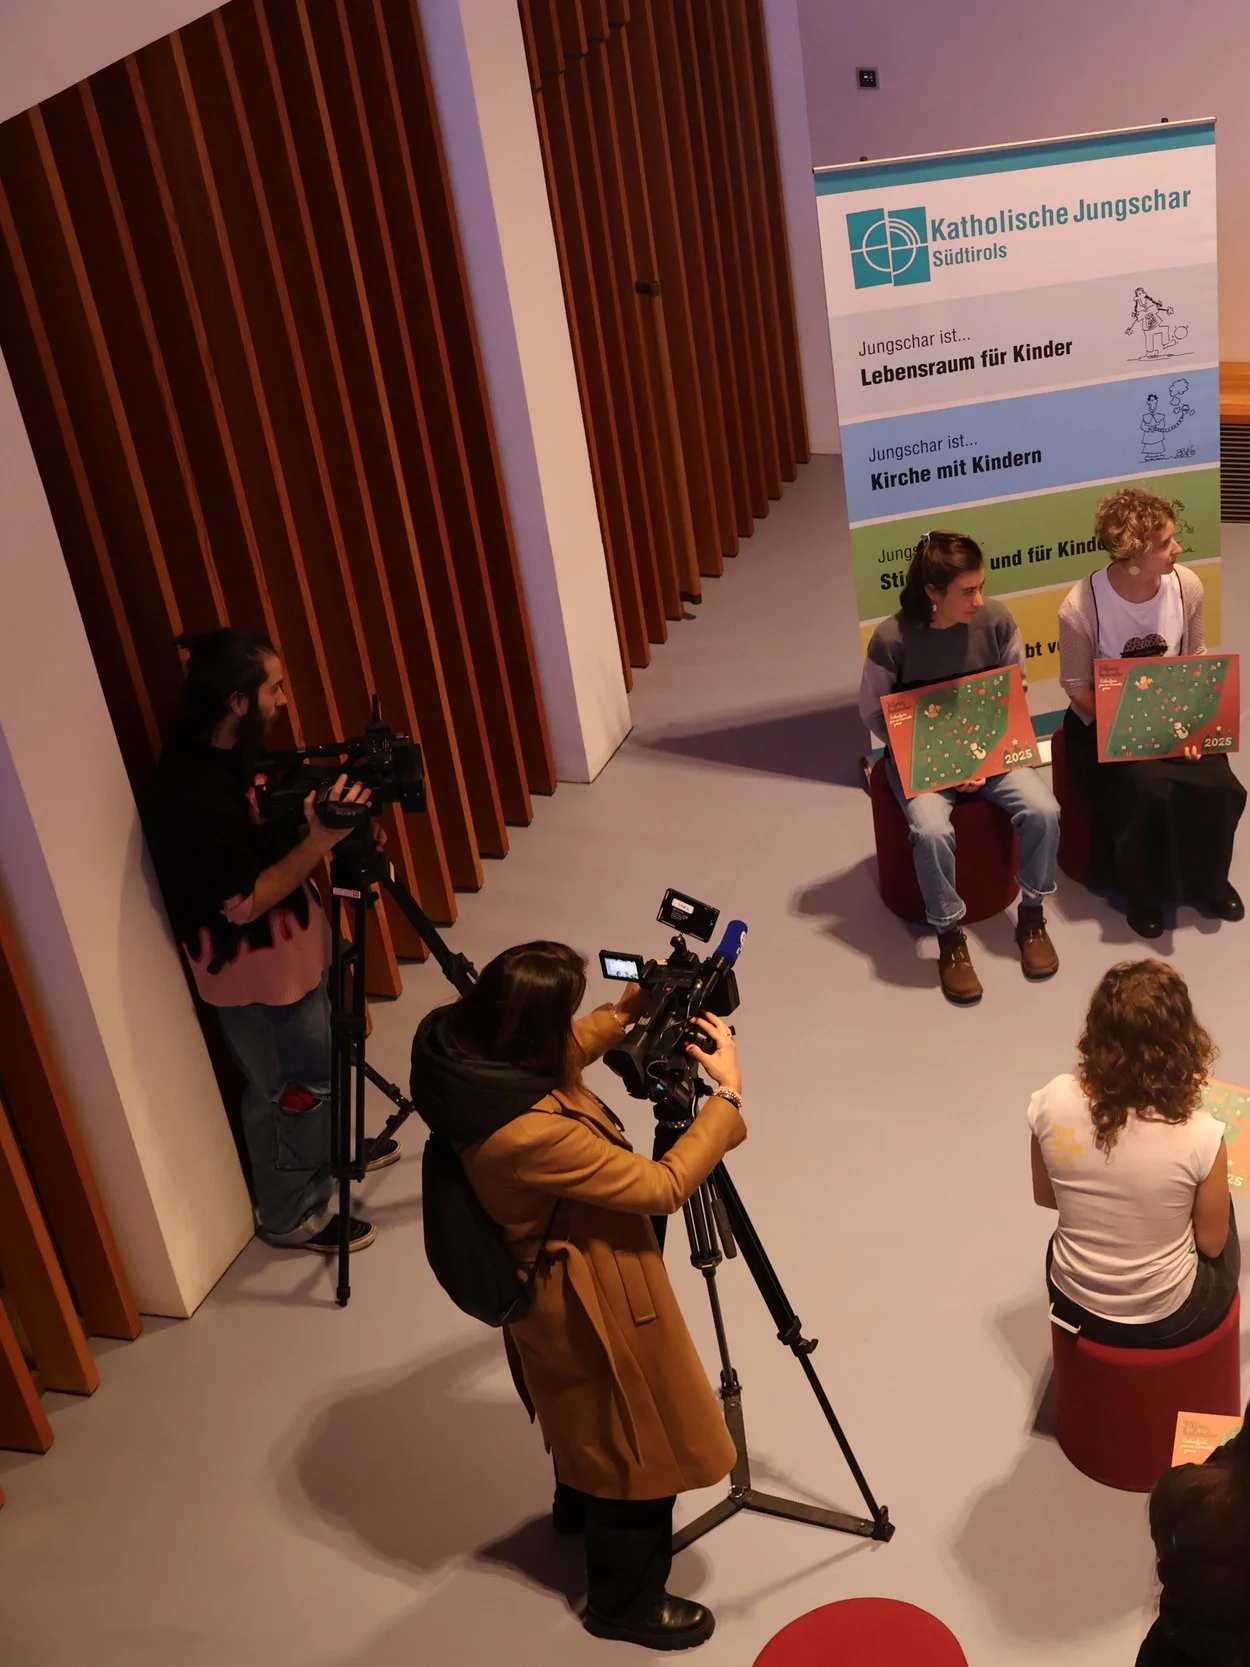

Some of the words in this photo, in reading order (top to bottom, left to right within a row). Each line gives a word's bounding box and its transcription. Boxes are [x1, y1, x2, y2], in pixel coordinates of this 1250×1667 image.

[930, 203, 1068, 242] Katholische
[1073, 188, 1192, 226] Jungschar
[932, 243, 1008, 268] Südtirols
[858, 333, 935, 357] Jungschar
[939, 328, 971, 344] ist...
[860, 352, 975, 387] Lebensraum
[981, 349, 1008, 368] für
[1013, 339, 1073, 363] Kinder
[868, 440, 943, 463] Jungschar
[870, 465, 931, 491] Kirche
[937, 461, 967, 480] mit
[972, 449, 1042, 474] Kindern
[881, 570, 908, 590] Sti
[990, 550, 1022, 571] und
[1028, 546, 1052, 564] für
[1025, 641, 1042, 659] bt
[1204, 736, 1232, 748] 2025
[1004, 749, 1033, 765] 2025
[1227, 1173, 1244, 1187] 25
